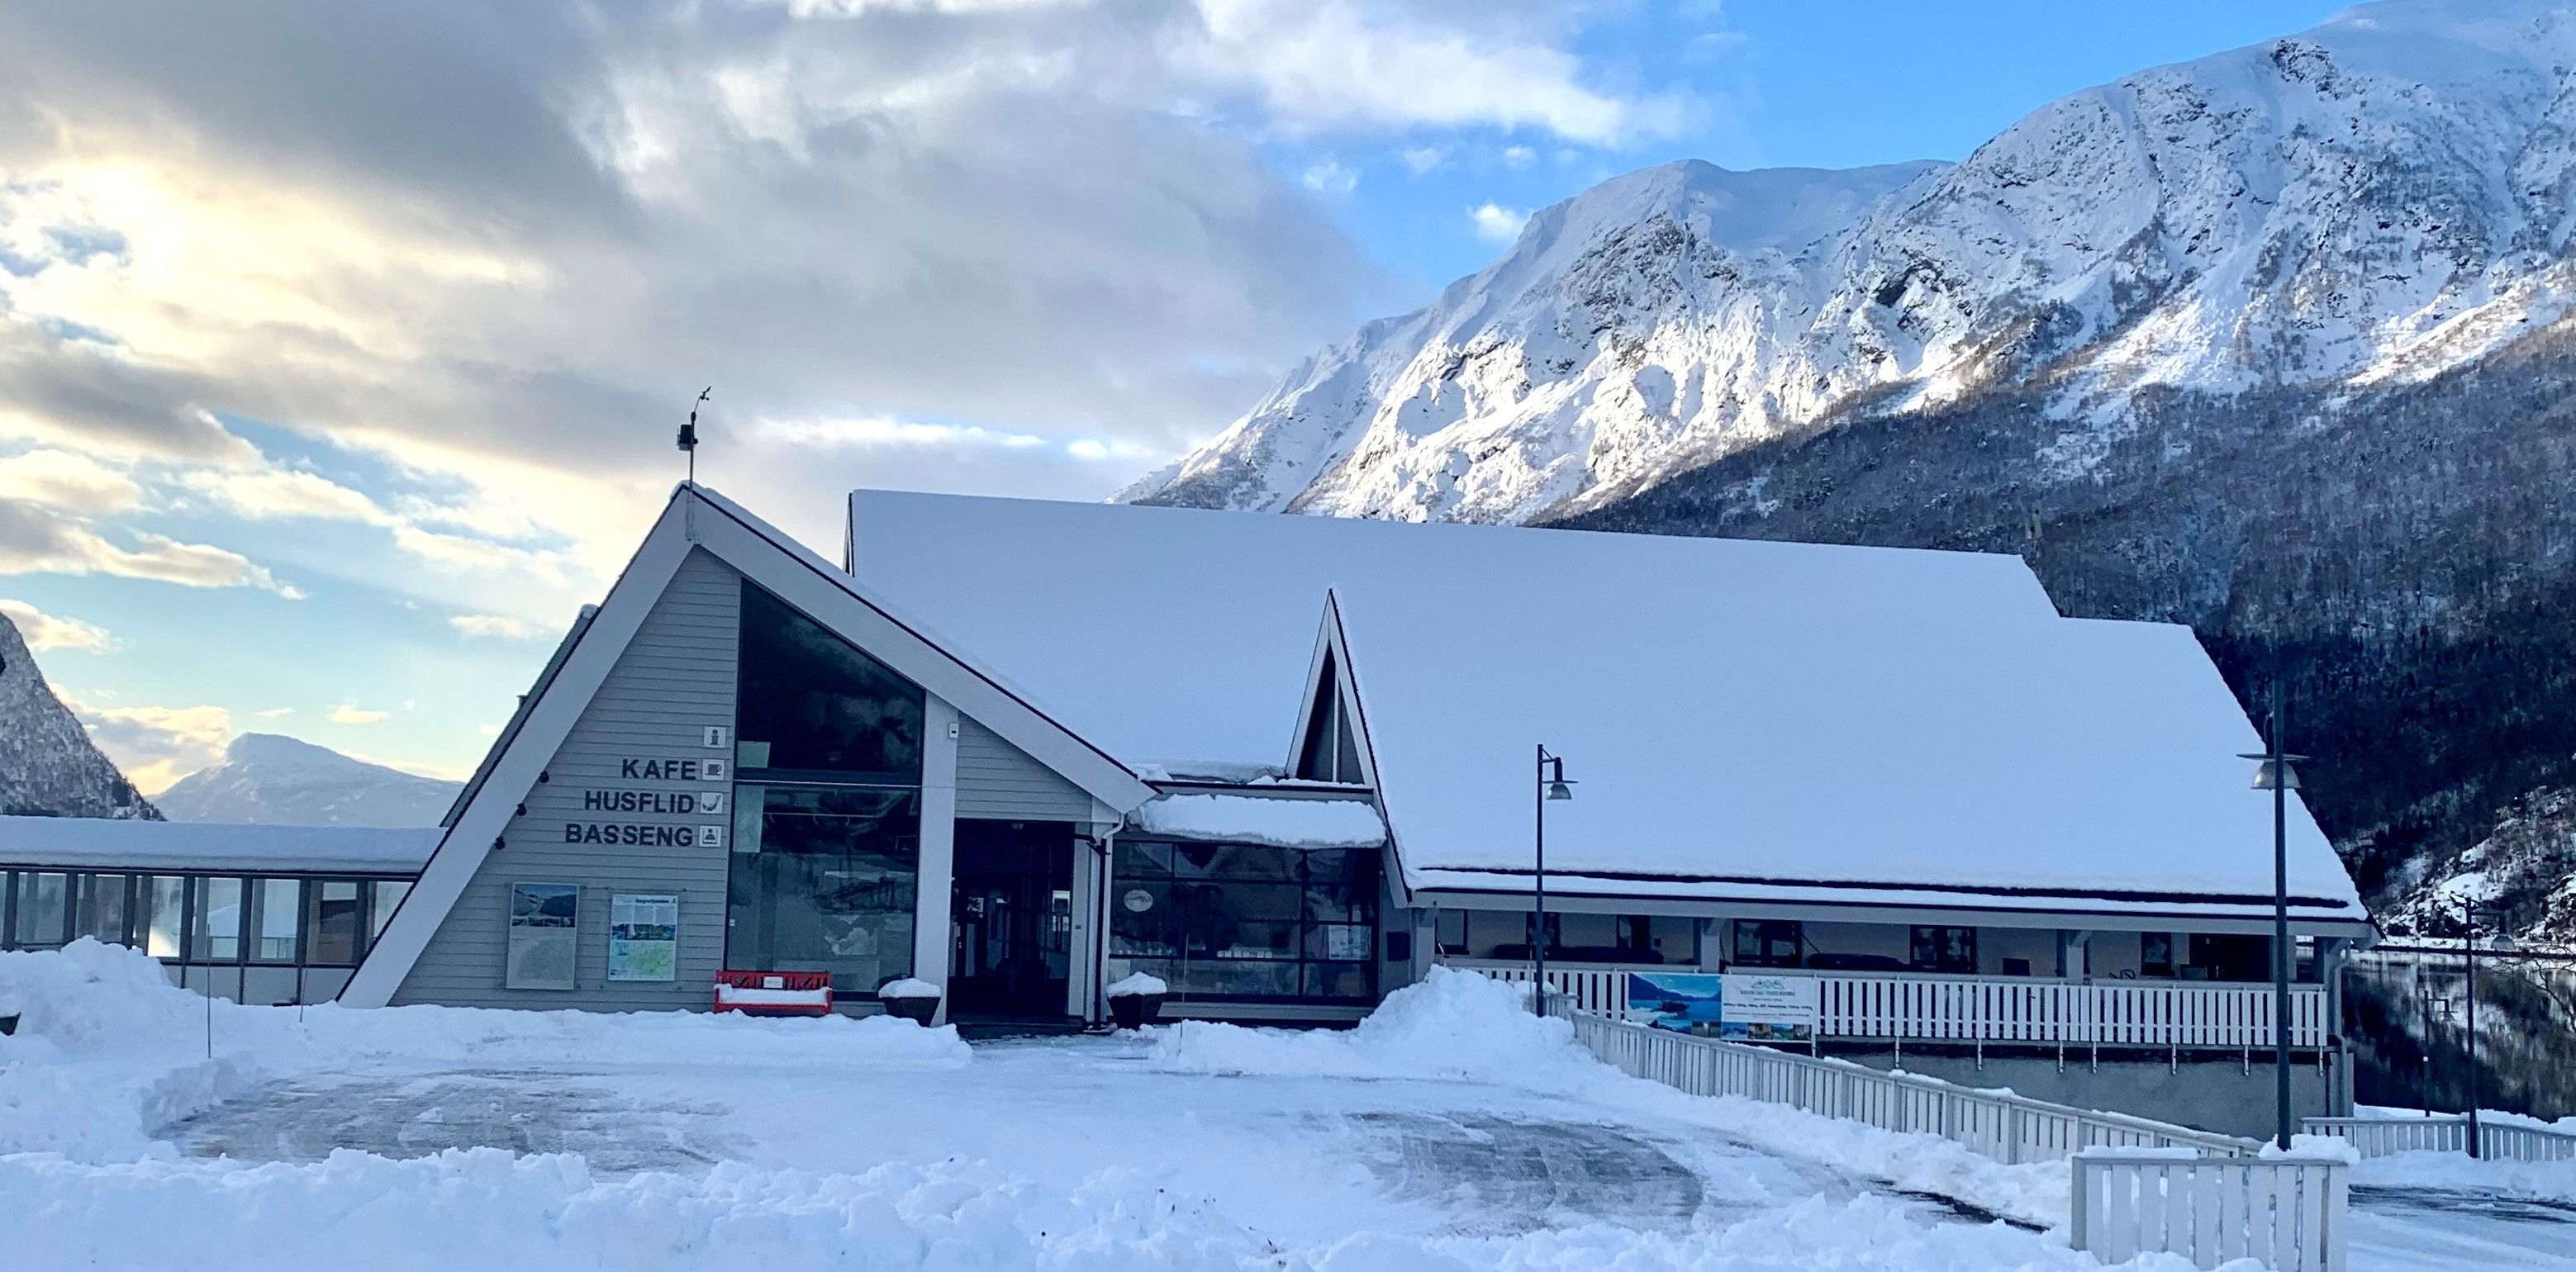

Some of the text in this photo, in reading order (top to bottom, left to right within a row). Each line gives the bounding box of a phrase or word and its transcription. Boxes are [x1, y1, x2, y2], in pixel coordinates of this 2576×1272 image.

[621, 758, 696, 781] KAFE
[584, 790, 695, 815] HUSFLID
[565, 823, 693, 847] BASSENG
